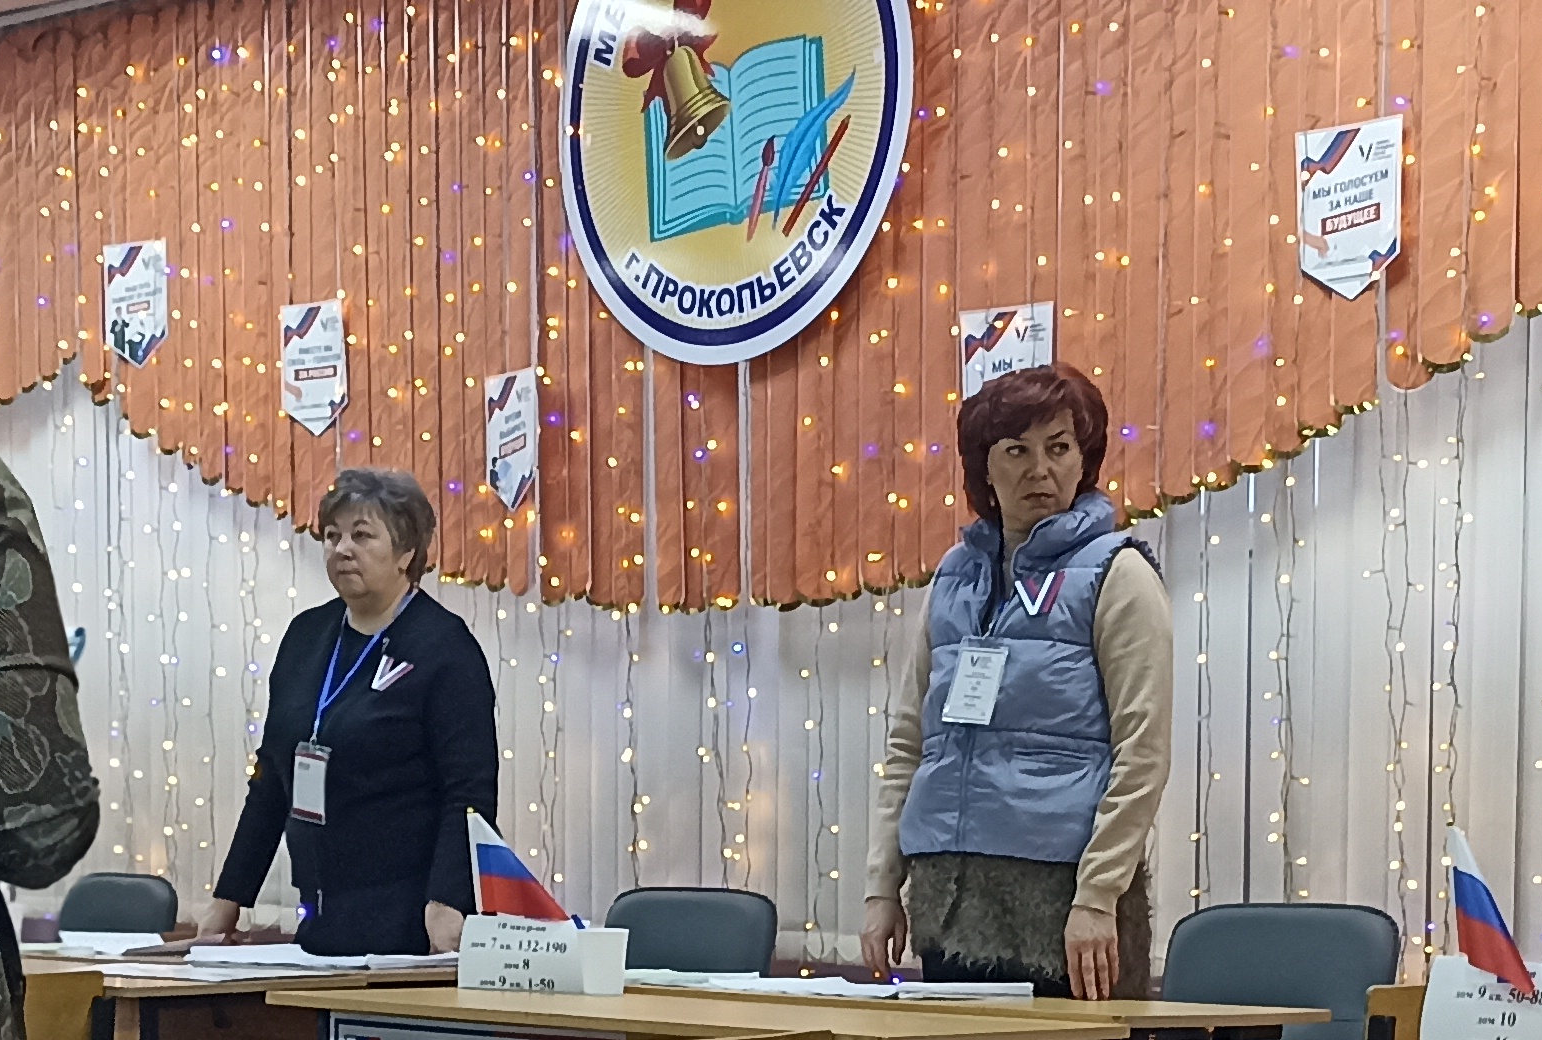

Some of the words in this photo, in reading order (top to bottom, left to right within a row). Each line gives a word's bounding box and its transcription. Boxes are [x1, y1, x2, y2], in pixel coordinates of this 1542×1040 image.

[1312, 186, 1331, 200] МЫ
[1334, 168, 1389, 194] ГОЛОСУЕМ
[1328, 199, 1342, 212] ЗА
[1345, 188, 1374, 206] НАШЕ
[1325, 205, 1377, 232] БУДУЩЕЕ
[991, 357, 1013, 373] МЫ
[518, 939, 568, 954] 132-190
[522, 958, 531, 970] 8
[498, 975, 507, 988] 9
[1478, 985, 1487, 998] 9
[1500, 1011, 1517, 1027] 10
